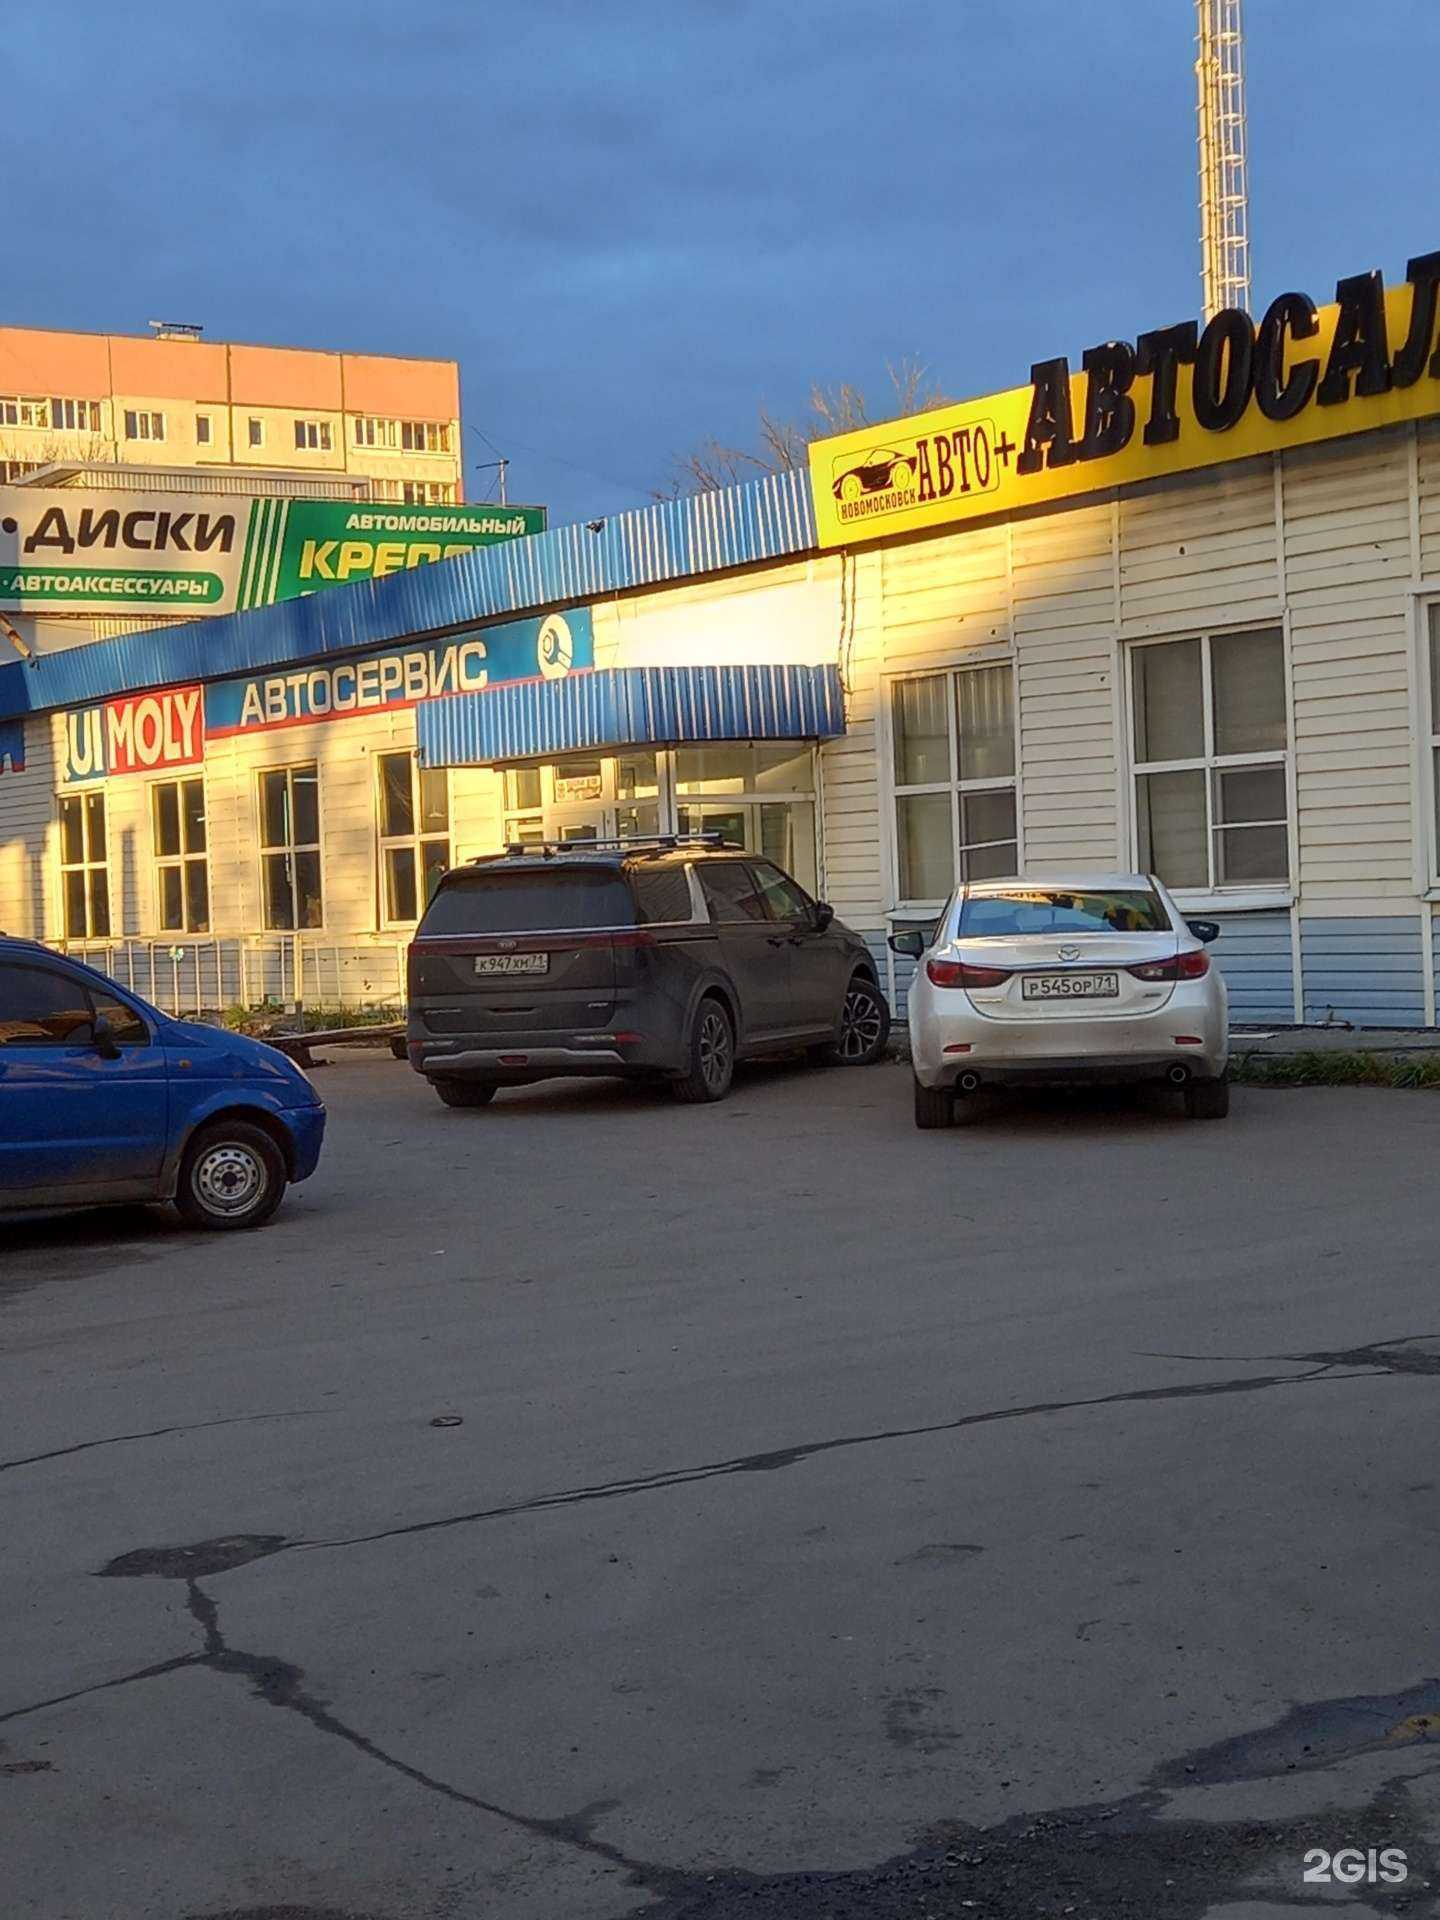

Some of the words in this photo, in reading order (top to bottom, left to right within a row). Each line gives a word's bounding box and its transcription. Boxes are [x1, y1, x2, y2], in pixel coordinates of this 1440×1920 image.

[840, 488, 916, 519] НОВОМОСКОВСК
[23, 507, 236, 554] ДИСКИ
[346, 514, 526, 535] АВТОМОБИЛЬНЫЙ
[10, 575, 209, 596] АВТОАКСЕССУАРЫ
[240, 641, 489, 727] АВТОСЕРВИС
[107, 690, 200, 769] MOLY
